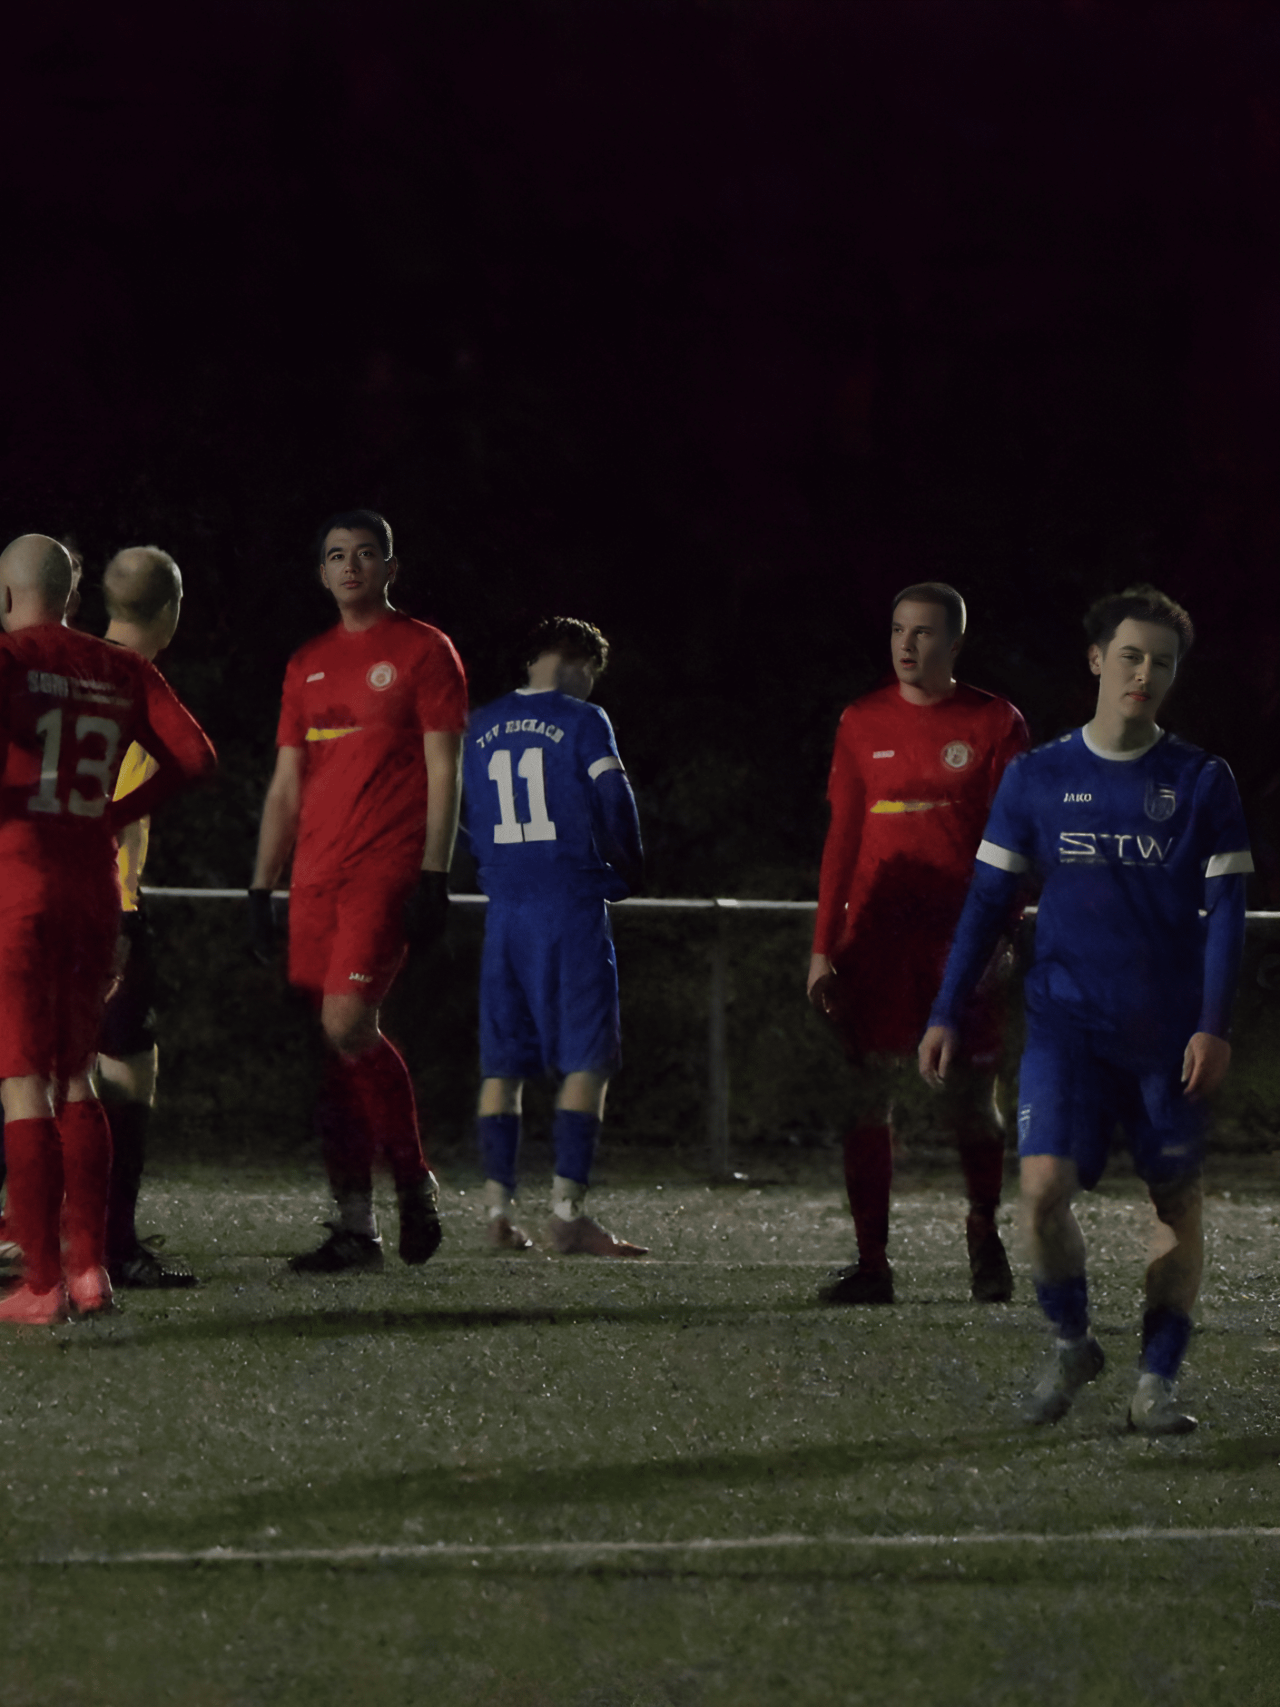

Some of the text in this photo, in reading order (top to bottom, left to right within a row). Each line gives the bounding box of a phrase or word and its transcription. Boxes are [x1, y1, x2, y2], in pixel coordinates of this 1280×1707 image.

[26, 708, 120, 818] 13
[487, 747, 557, 844] 11
[1063, 792, 1092, 803] JAKO
[1058, 831, 1175, 862] STW
